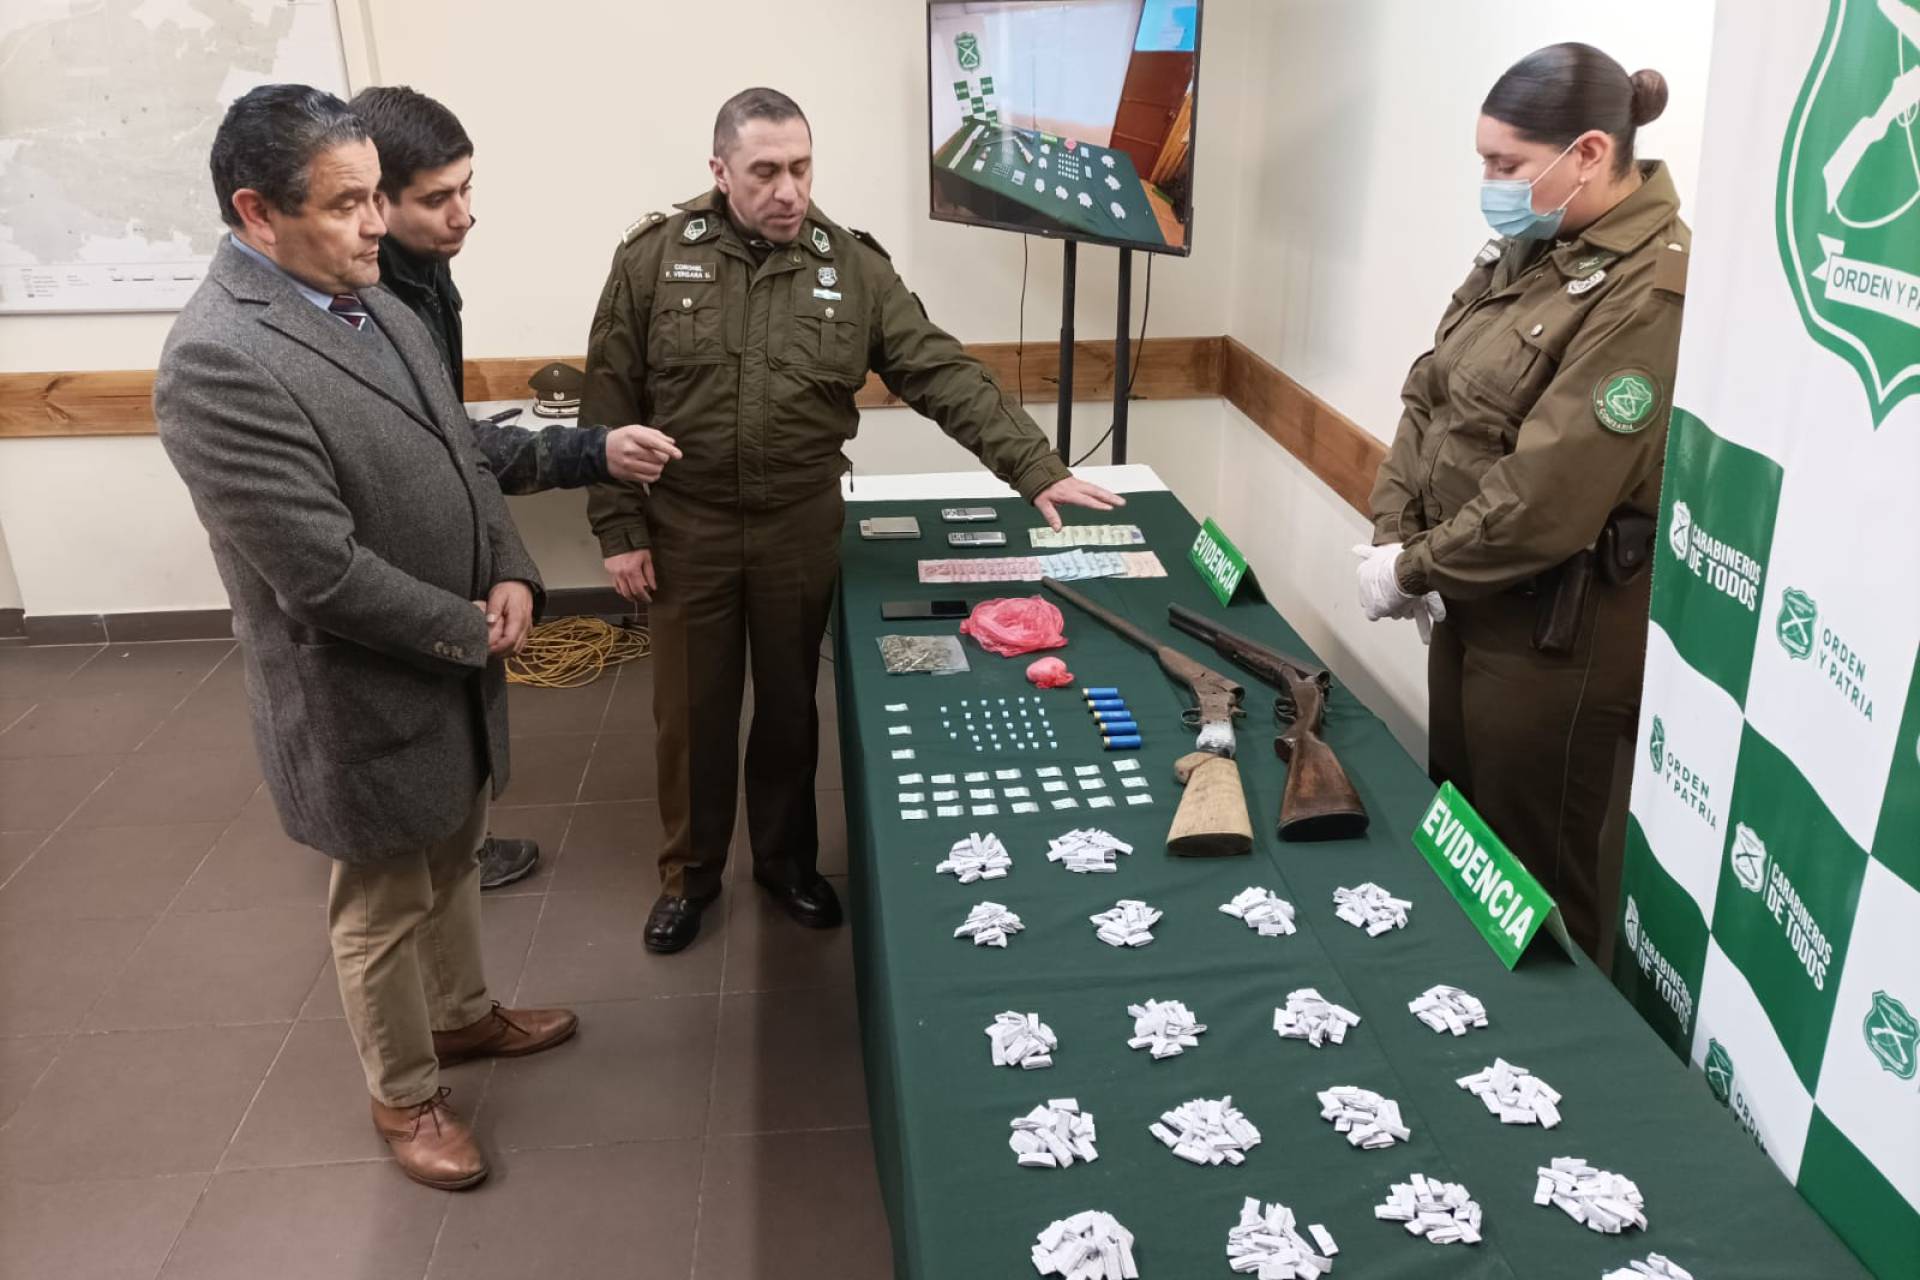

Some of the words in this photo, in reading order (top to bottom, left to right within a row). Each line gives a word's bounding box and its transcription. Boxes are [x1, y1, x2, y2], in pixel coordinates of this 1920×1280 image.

[1833, 266, 1892, 300] ORDEN
[1897, 281, 1906, 304] Y
[1193, 528, 1240, 596] EVIDENCIA
[1688, 544, 1704, 577] DE
[1706, 558, 1758, 612] TODOS
[1692, 523, 1762, 586] CARABINEROS
[1819, 649, 1827, 669] Y
[1829, 662, 1873, 722] PATRIA
[1823, 628, 1866, 682] ORDEN
[1666, 768, 1672, 784] Y
[1674, 779, 1716, 831] PATRIA
[1667, 752, 1709, 799] ORDEN
[1422, 798, 1534, 949] EVIDENCIA
[1766, 883, 1786, 925] DE
[1786, 909, 1827, 991] TODOS
[1771, 863, 1833, 966] CARABINEROS
[1638, 945, 1652, 980] DE
[1654, 968, 1690, 1036] TODOS
[1641, 929, 1693, 1016] CARABINEROS
